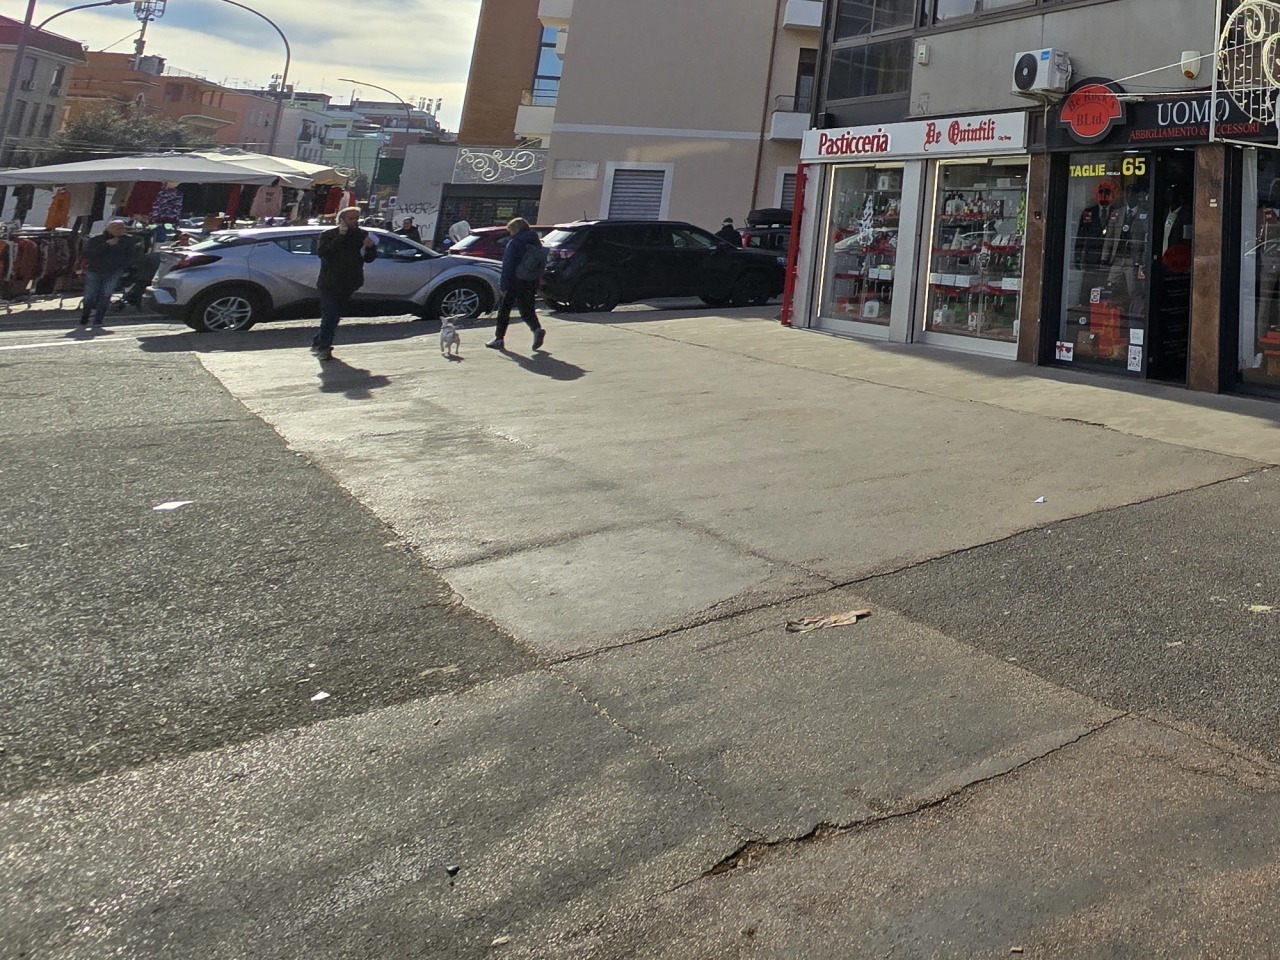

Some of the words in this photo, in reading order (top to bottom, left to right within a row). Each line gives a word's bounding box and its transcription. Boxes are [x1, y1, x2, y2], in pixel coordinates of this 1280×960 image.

[1157, 97, 1230, 126] UOMO
[818, 127, 889, 155] Pasticceria
[1130, 126, 1198, 140] ABBIGLIAMENTO
[1210, 122, 1260, 136] CCESSORI
[1069, 163, 1106, 177] TAGLIE
[1122, 157, 1146, 176] 65
